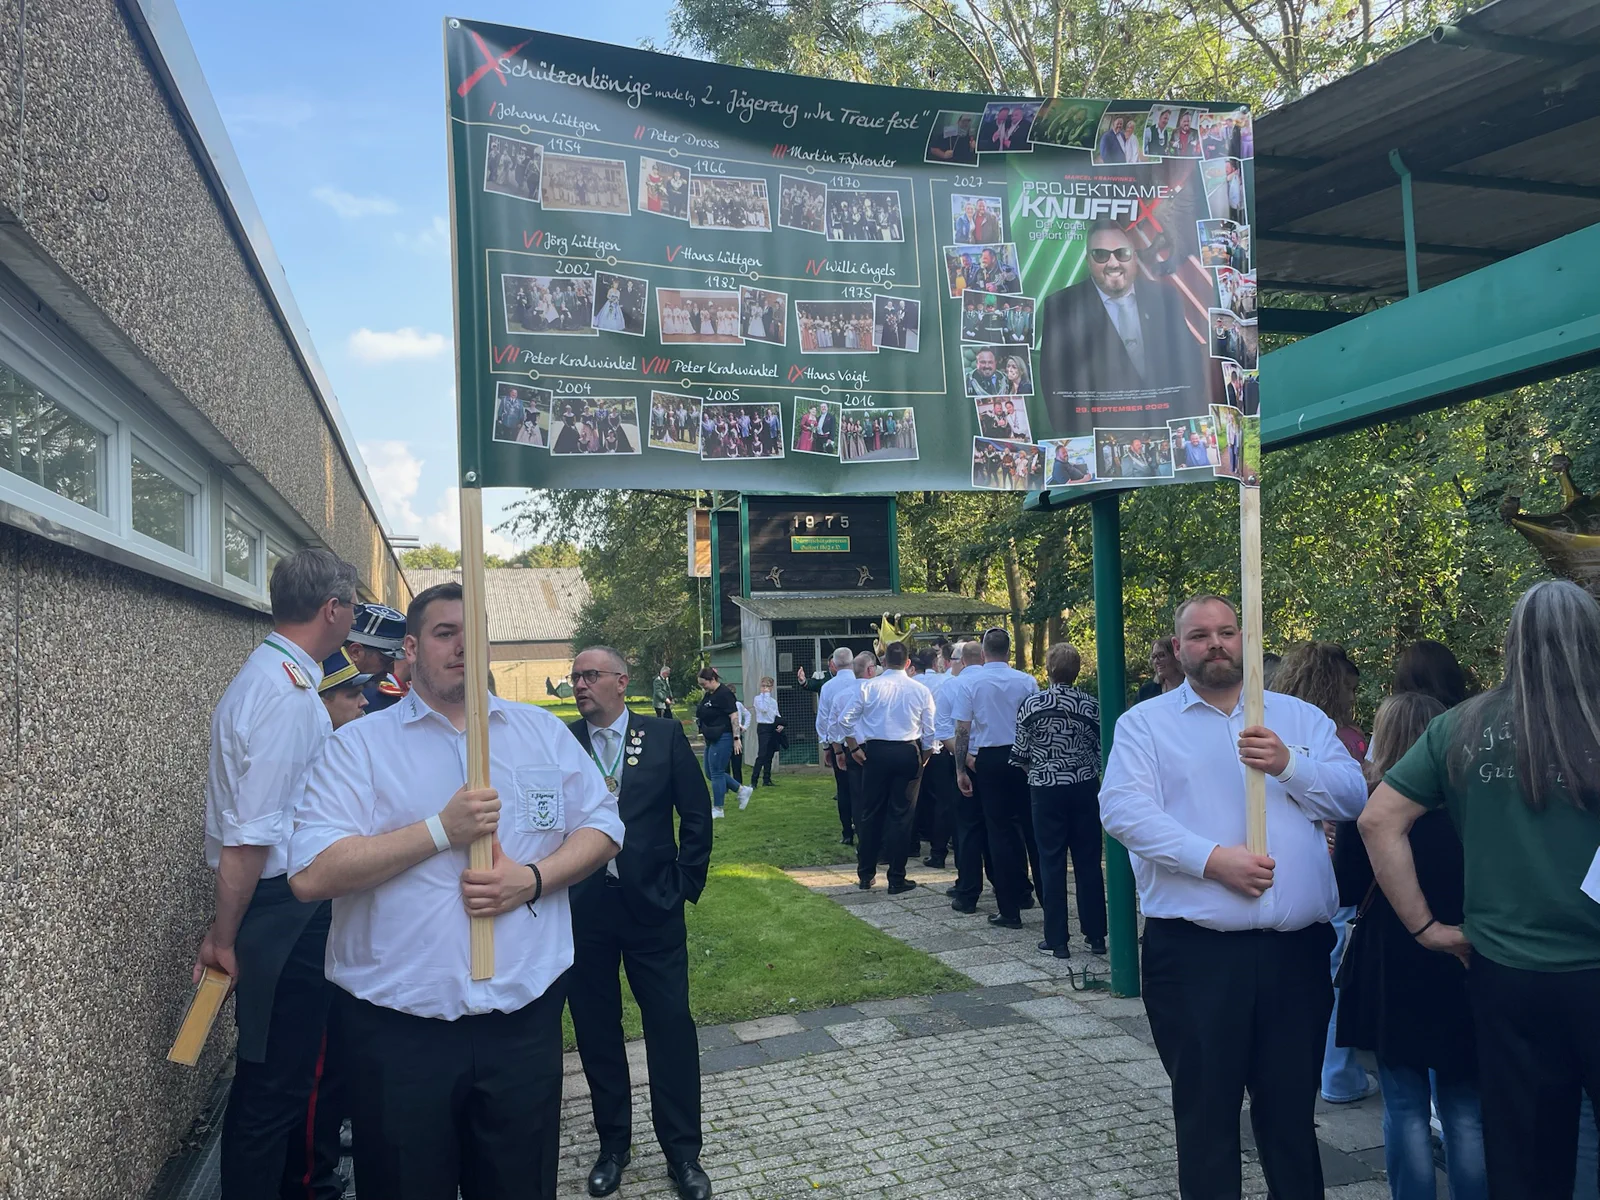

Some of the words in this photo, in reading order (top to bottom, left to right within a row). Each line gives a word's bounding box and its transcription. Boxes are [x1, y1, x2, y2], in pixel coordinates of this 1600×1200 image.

[496, 58, 653, 110] Schützenkönige
[655, 89, 684, 101] made
[684, 88, 696, 107] by
[701, 85, 721, 105] 2.
[726, 88, 799, 129] Jägerzug
[840, 108, 885, 129] Treue
[497, 102, 550, 123] Johann
[551, 112, 602, 138] Lüttgen
[647, 128, 681, 144] Peter
[682, 132, 720, 149] Dross
[547, 139, 582, 154] 1954
[787, 146, 836, 163] Martin
[838, 151, 898, 169] Faßbender
[694, 161, 727, 174] 1966
[829, 176, 861, 189] 1970
[953, 174, 984, 189] 2027
[1022, 181, 1175, 199] PROJEKTNAME:
[1056, 220, 1087, 232] Vogel
[523, 230, 543, 249] VI
[543, 232, 568, 256] Jörg
[571, 234, 621, 259] Lüttgen
[666, 245, 682, 262] V
[681, 247, 714, 263] Hans
[717, 251, 763, 274] Lüttgen
[555, 261, 592, 276] 2002
[805, 258, 827, 276] IV
[825, 260, 857, 274] Willi
[860, 262, 896, 284] Engels
[704, 276, 737, 290] 1982
[841, 286, 872, 299] 1975
[493, 344, 520, 364] VII
[520, 350, 557, 366] Peter
[559, 353, 637, 371] Krahwinkel
[641, 356, 671, 375] VIII
[671, 360, 706, 374] Peter
[707, 361, 779, 379] Krahwinkel
[787, 364, 809, 383] IX
[803, 366, 836, 381] Hans
[838, 370, 870, 391] Voigt
[556, 380, 592, 394] 2004
[706, 389, 740, 401] 2005
[843, 394, 875, 407] 2016
[1091, 405, 1144, 413] SEPTEMBER
[793, 515, 850, 529] 1975
